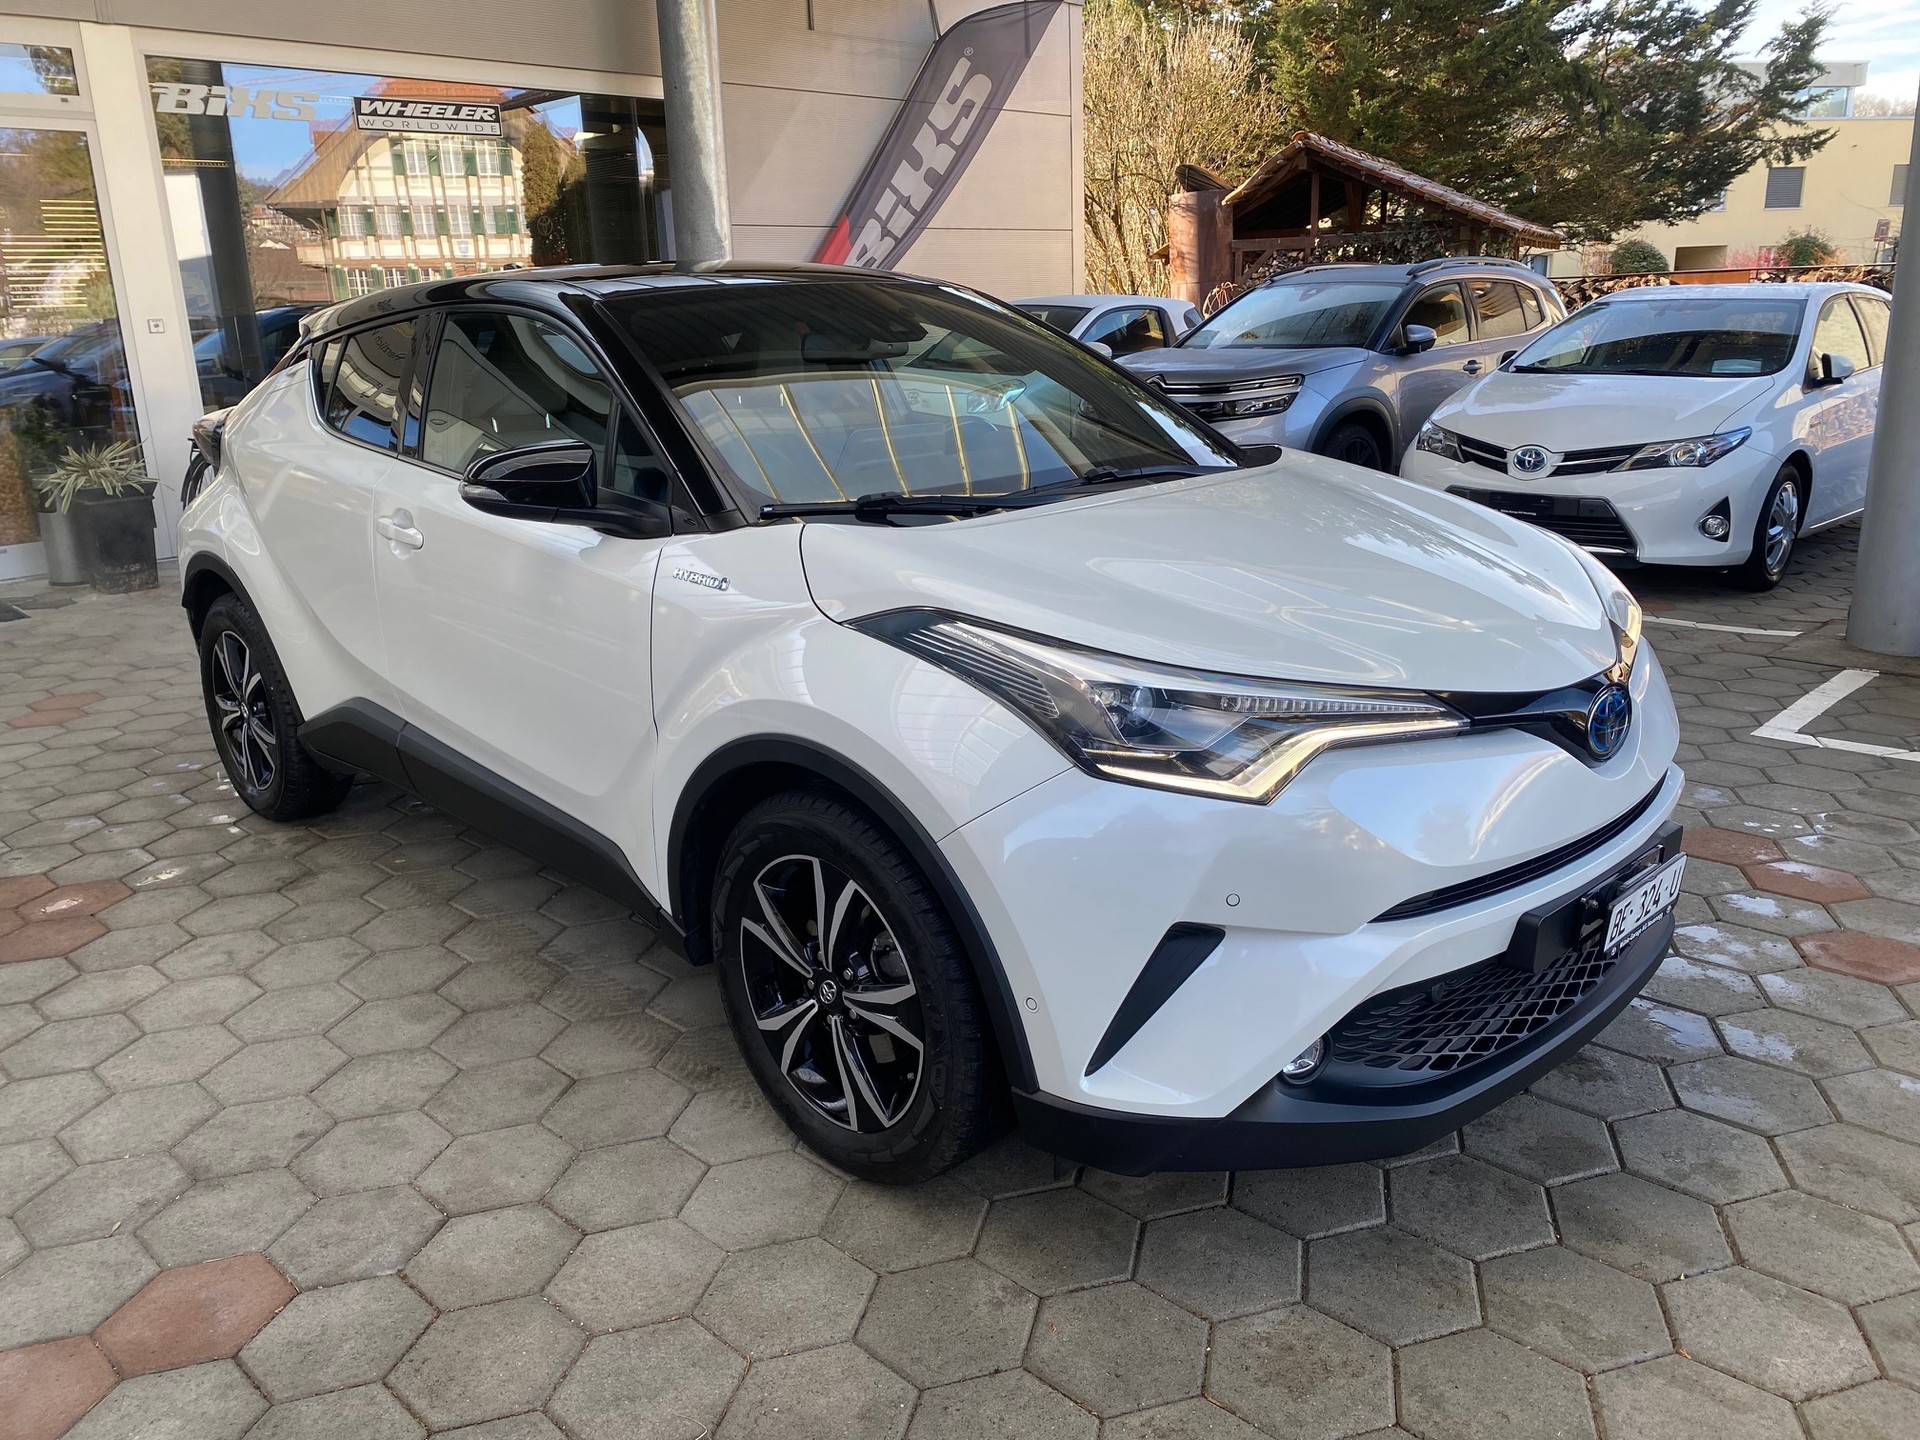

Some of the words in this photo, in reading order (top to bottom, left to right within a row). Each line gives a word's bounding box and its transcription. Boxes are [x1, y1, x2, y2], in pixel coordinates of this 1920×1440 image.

[358, 100, 497, 121] WHEELER
[361, 118, 498, 134] WORLDWIDE
[673, 567, 721, 589] HYBRID
